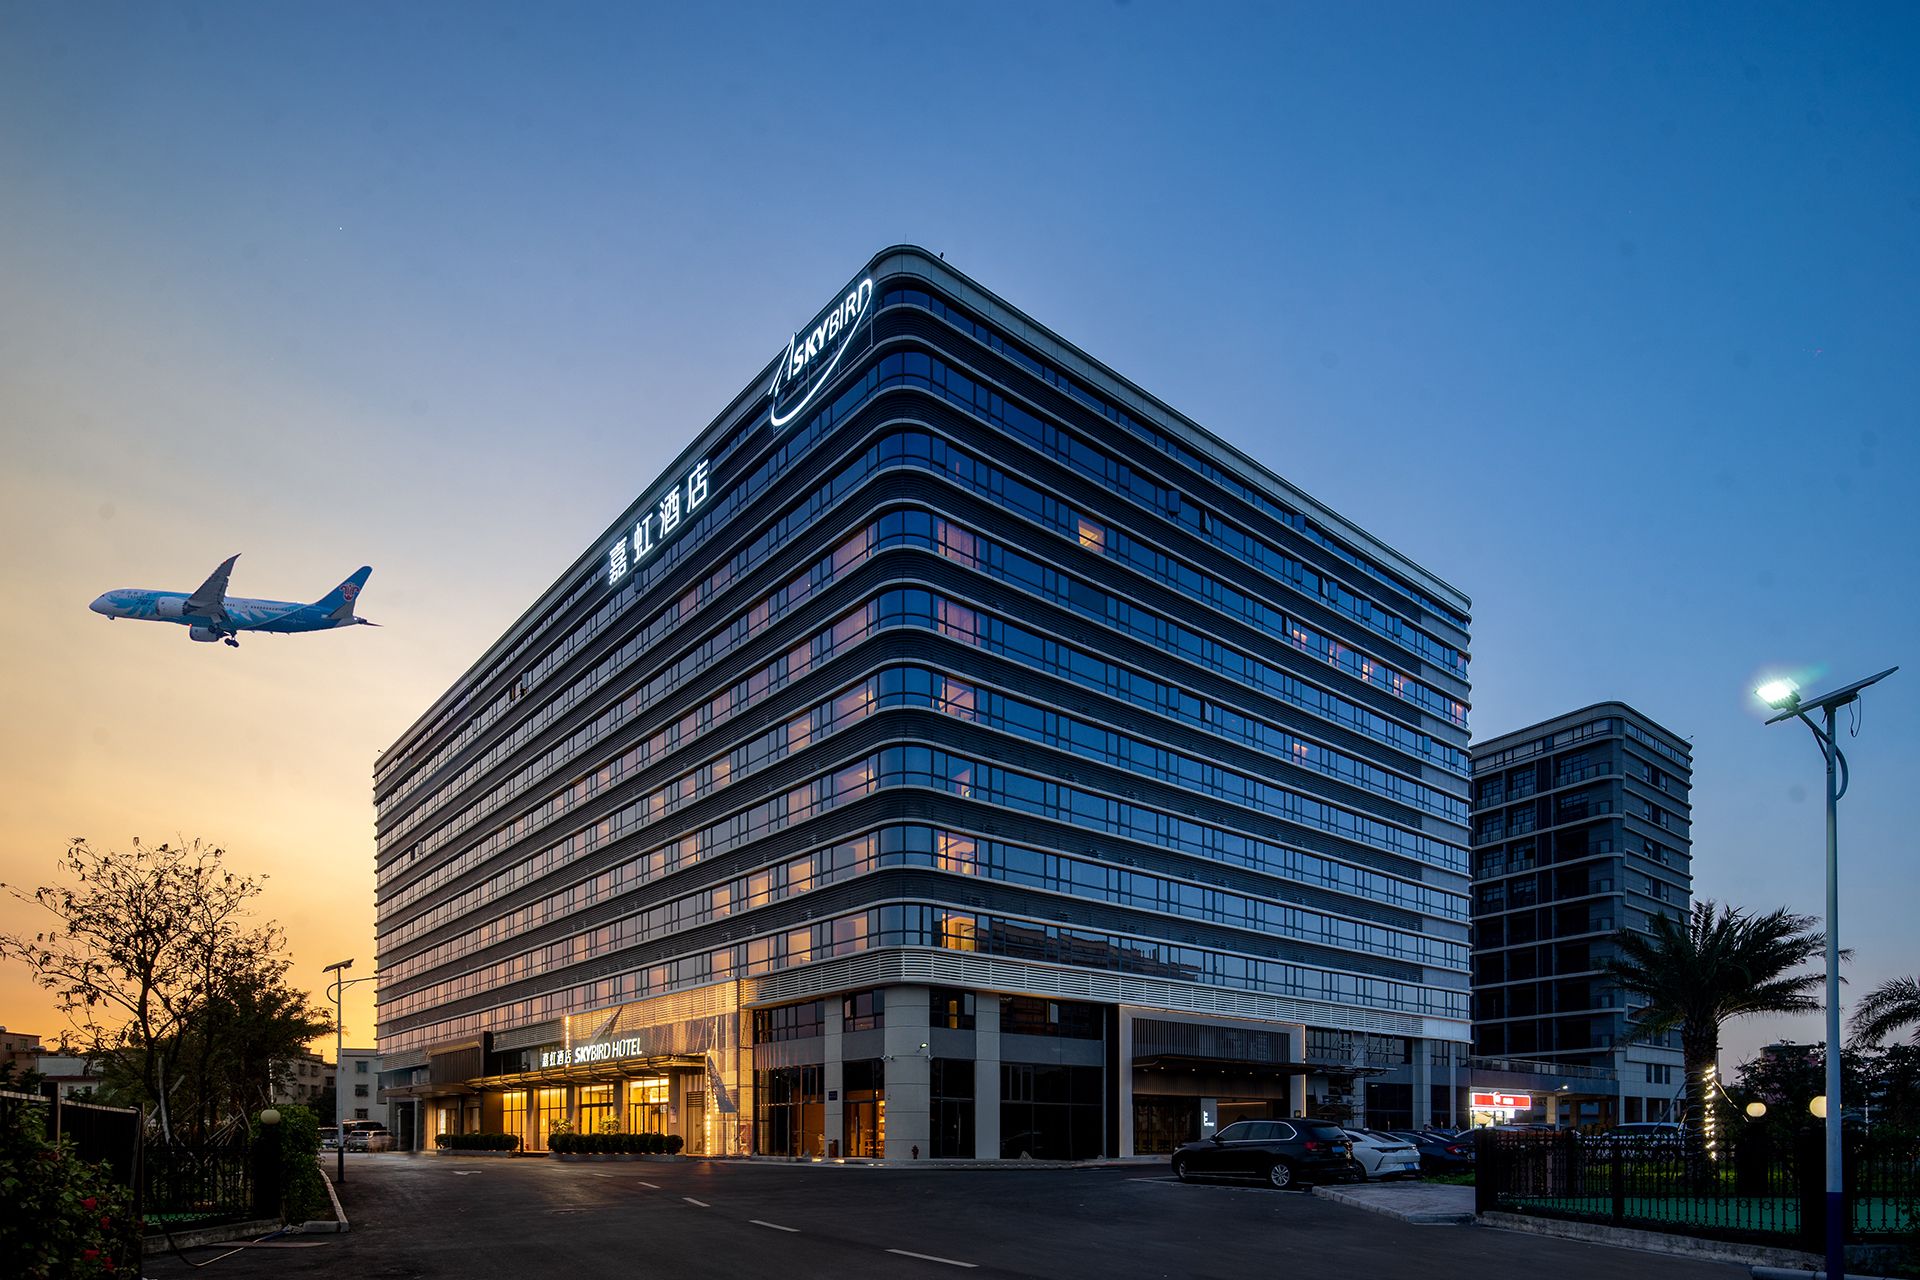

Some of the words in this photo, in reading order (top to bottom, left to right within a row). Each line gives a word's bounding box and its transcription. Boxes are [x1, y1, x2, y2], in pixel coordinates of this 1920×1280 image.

[792, 278, 873, 376] SKYBIRD
[608, 459, 708, 585] 嘉虹酒店
[542, 1050, 572, 1067] 嘉虹酒店
[574, 1043, 611, 1063] SKYBIRD
[611, 1037, 642, 1058] HOTEL
